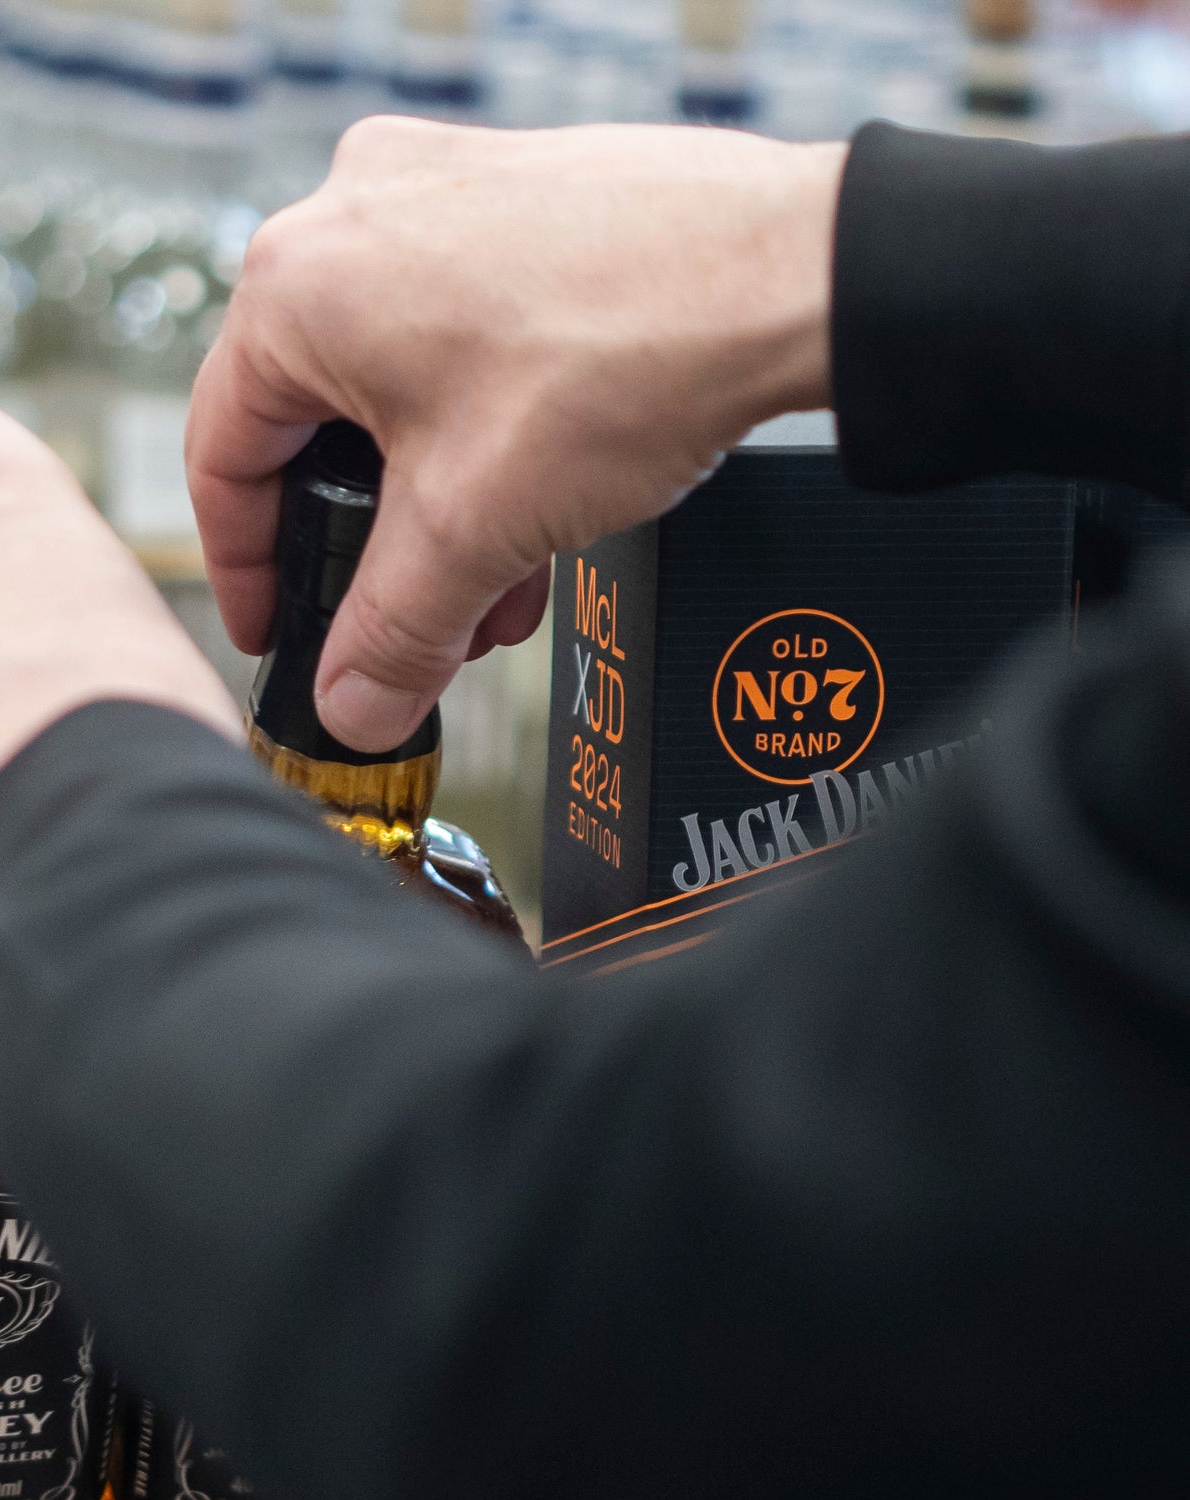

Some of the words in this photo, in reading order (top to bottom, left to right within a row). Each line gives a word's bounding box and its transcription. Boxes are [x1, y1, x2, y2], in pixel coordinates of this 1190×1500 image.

[772, 634, 828, 660] OLD
[755, 732, 841, 757] BRAND
[571, 735, 623, 819] 2024
[568, 802, 622, 869] EDITION
[672, 794, 814, 892] JACK
[11, 1441, 27, 1450] BY
